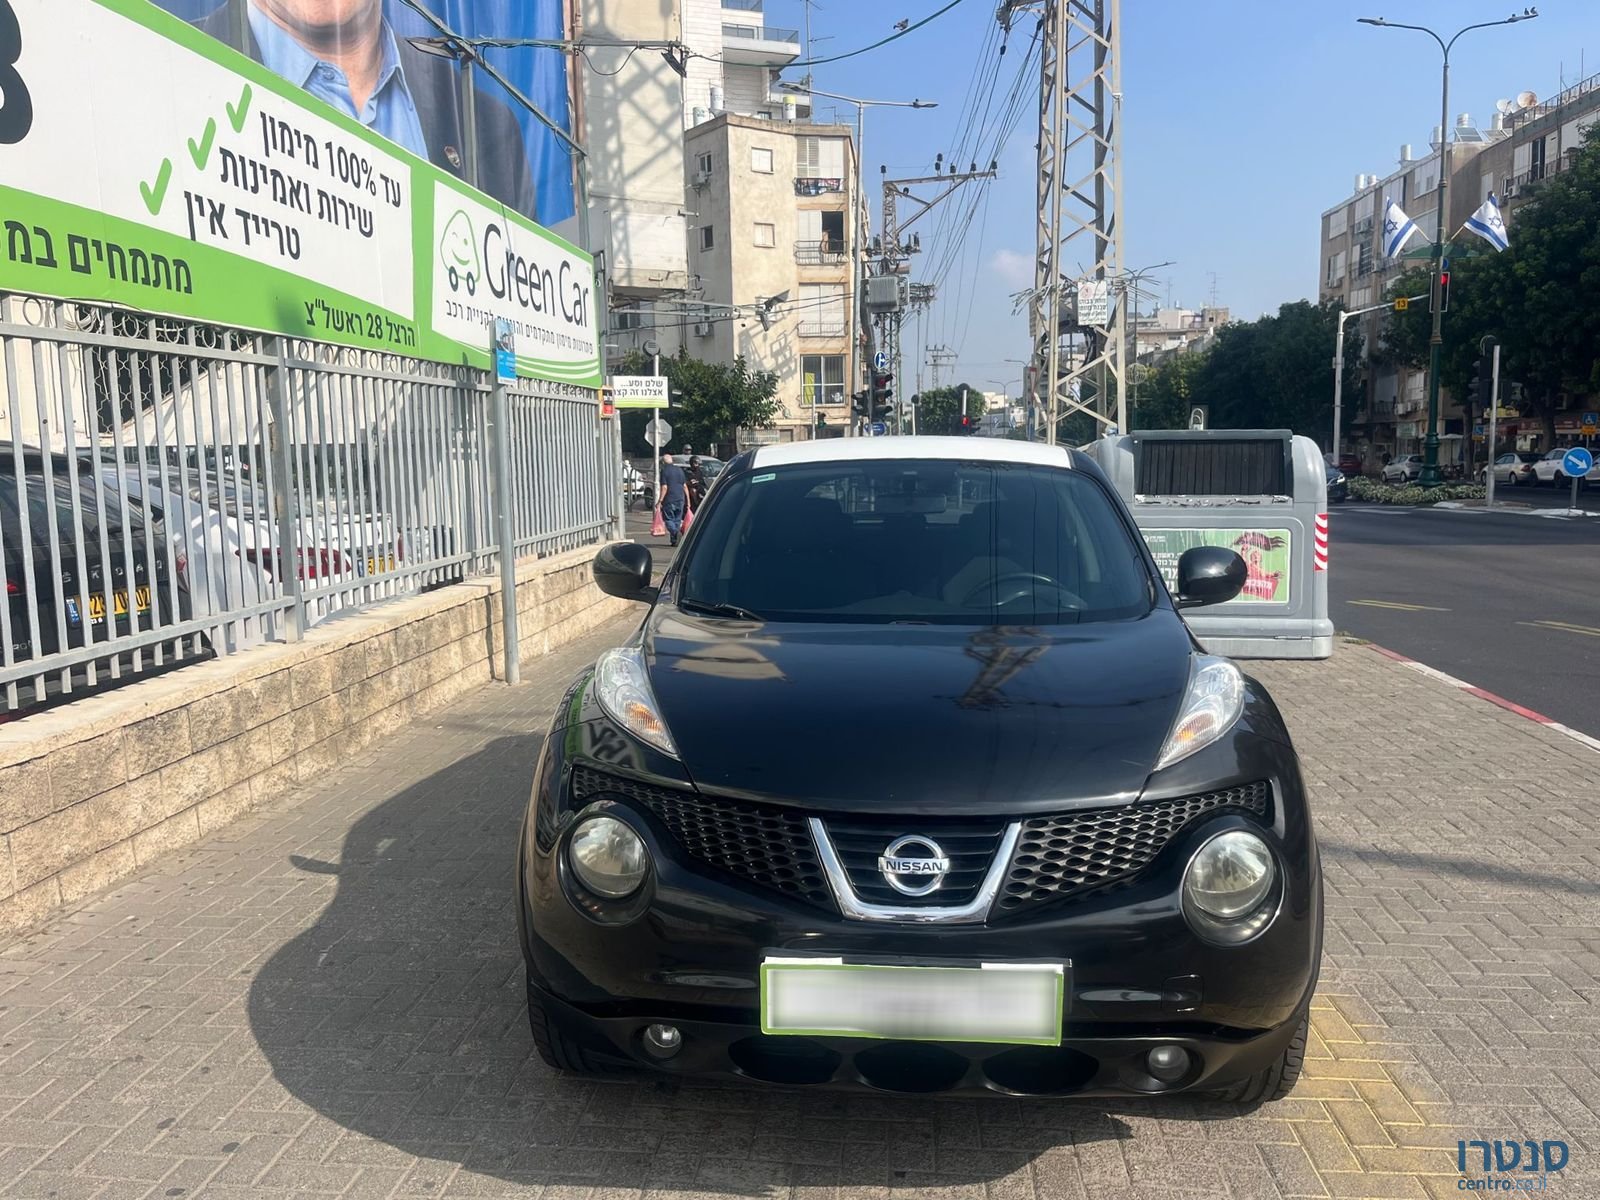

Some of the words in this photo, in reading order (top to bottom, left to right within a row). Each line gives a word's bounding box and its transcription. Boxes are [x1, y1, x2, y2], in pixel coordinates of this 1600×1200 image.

[260, 111, 319, 170] מימון
[219, 146, 311, 215] ואמינות
[325, 141, 376, 196] 100%
[380, 173, 401, 208] עד
[184, 190, 229, 241] אין
[235, 208, 301, 260] טרייד
[317, 189, 373, 238] שירות
[1, 220, 58, 268] במ
[67, 233, 193, 294] מתמחים
[484, 223, 555, 317] Green
[559, 260, 589, 328] Car
[446, 300, 464, 319] רכב
[1398, 299, 1406, 309] 13
[366, 312, 383, 339] 28
[386, 316, 415, 347] הרצל
[629, 388, 639, 396] זה
[641, 388, 663, 396] אצלנו
[645, 379, 663, 387] שלם
[886, 860, 942, 871] NISSAN
